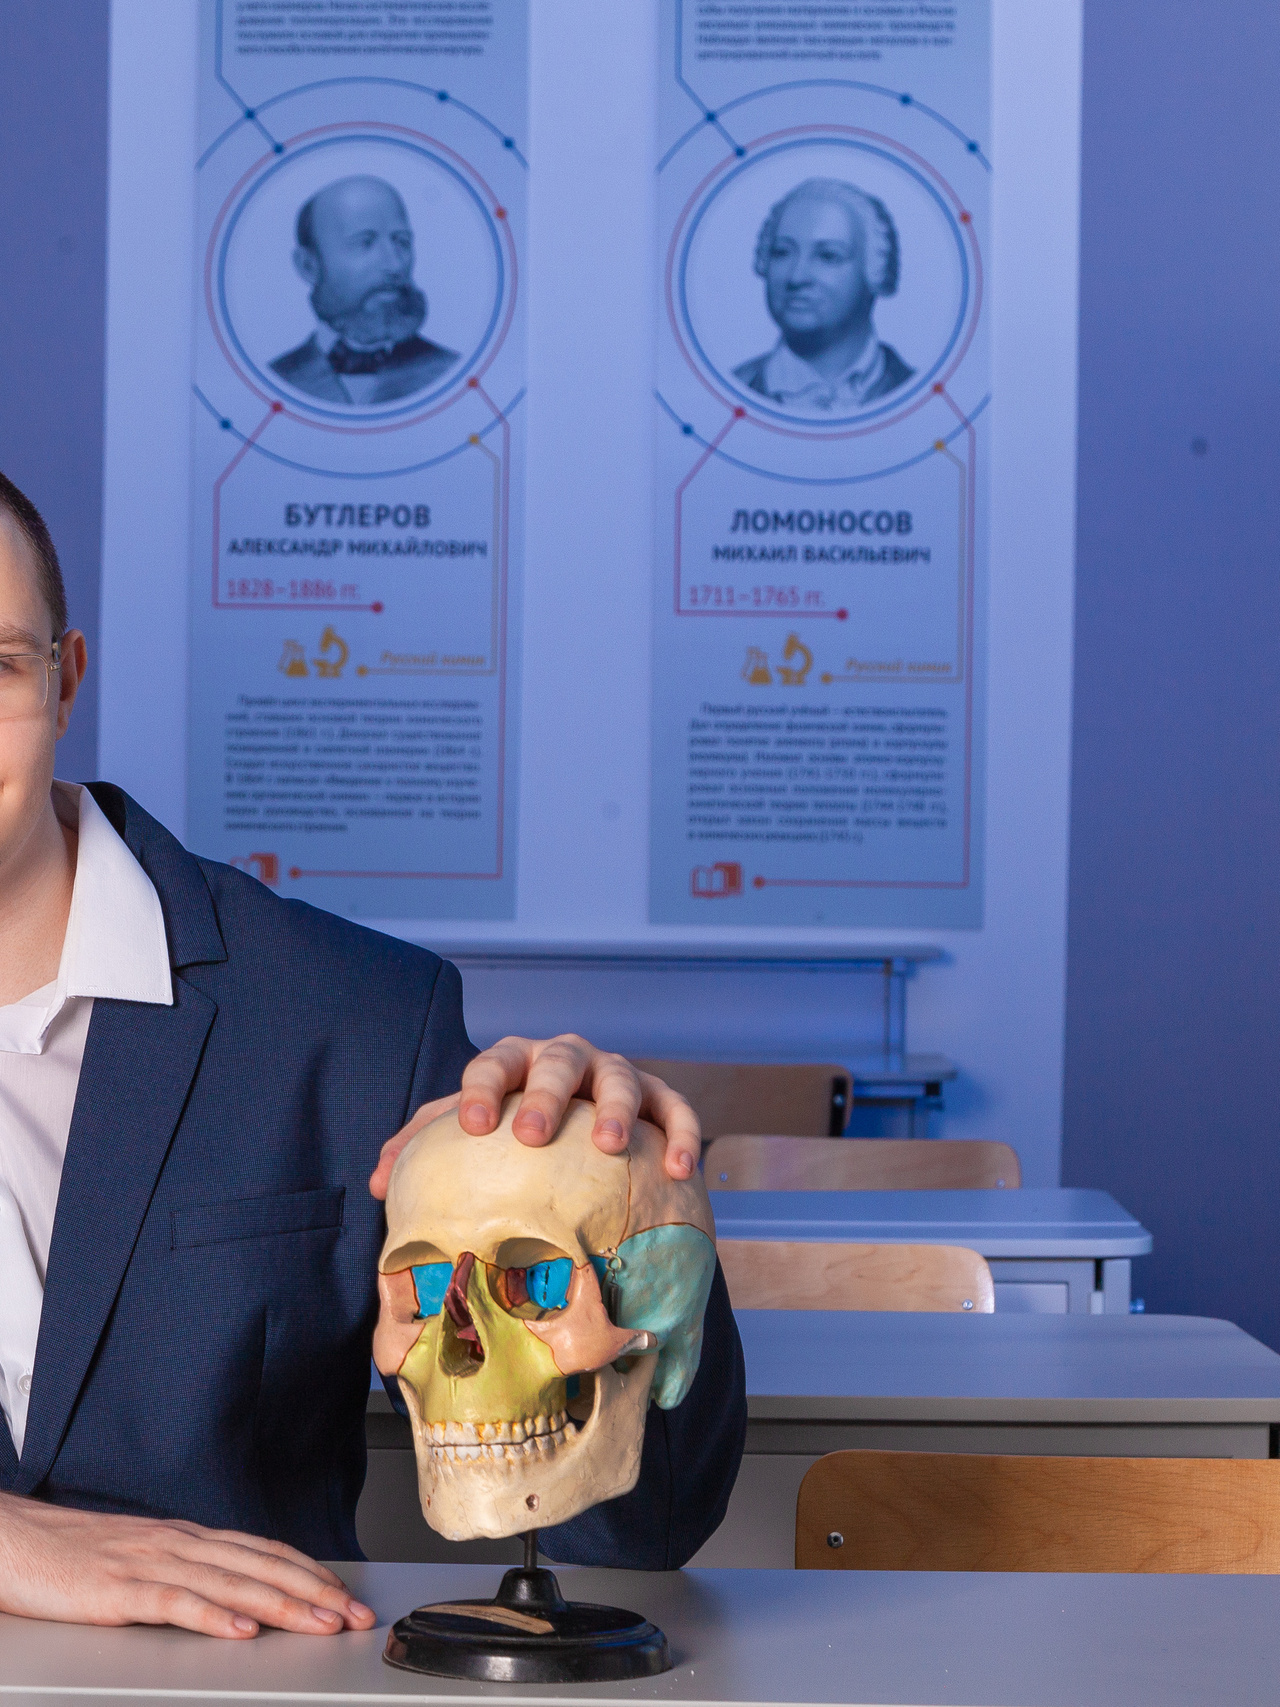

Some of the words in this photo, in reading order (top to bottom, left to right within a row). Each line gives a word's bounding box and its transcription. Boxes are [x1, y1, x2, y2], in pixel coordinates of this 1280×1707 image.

[284, 503, 431, 528] БУТЛЕРОВ
[730, 508, 914, 536] ЛОМОНОСОВ
[227, 537, 343, 558] АЛЕКСАНДР
[347, 536, 488, 558] МИХАЙЛОВИЧ
[711, 544, 798, 564] МИХАИЛ
[803, 545, 932, 565] ВАСИЛЬЕВИЧ
